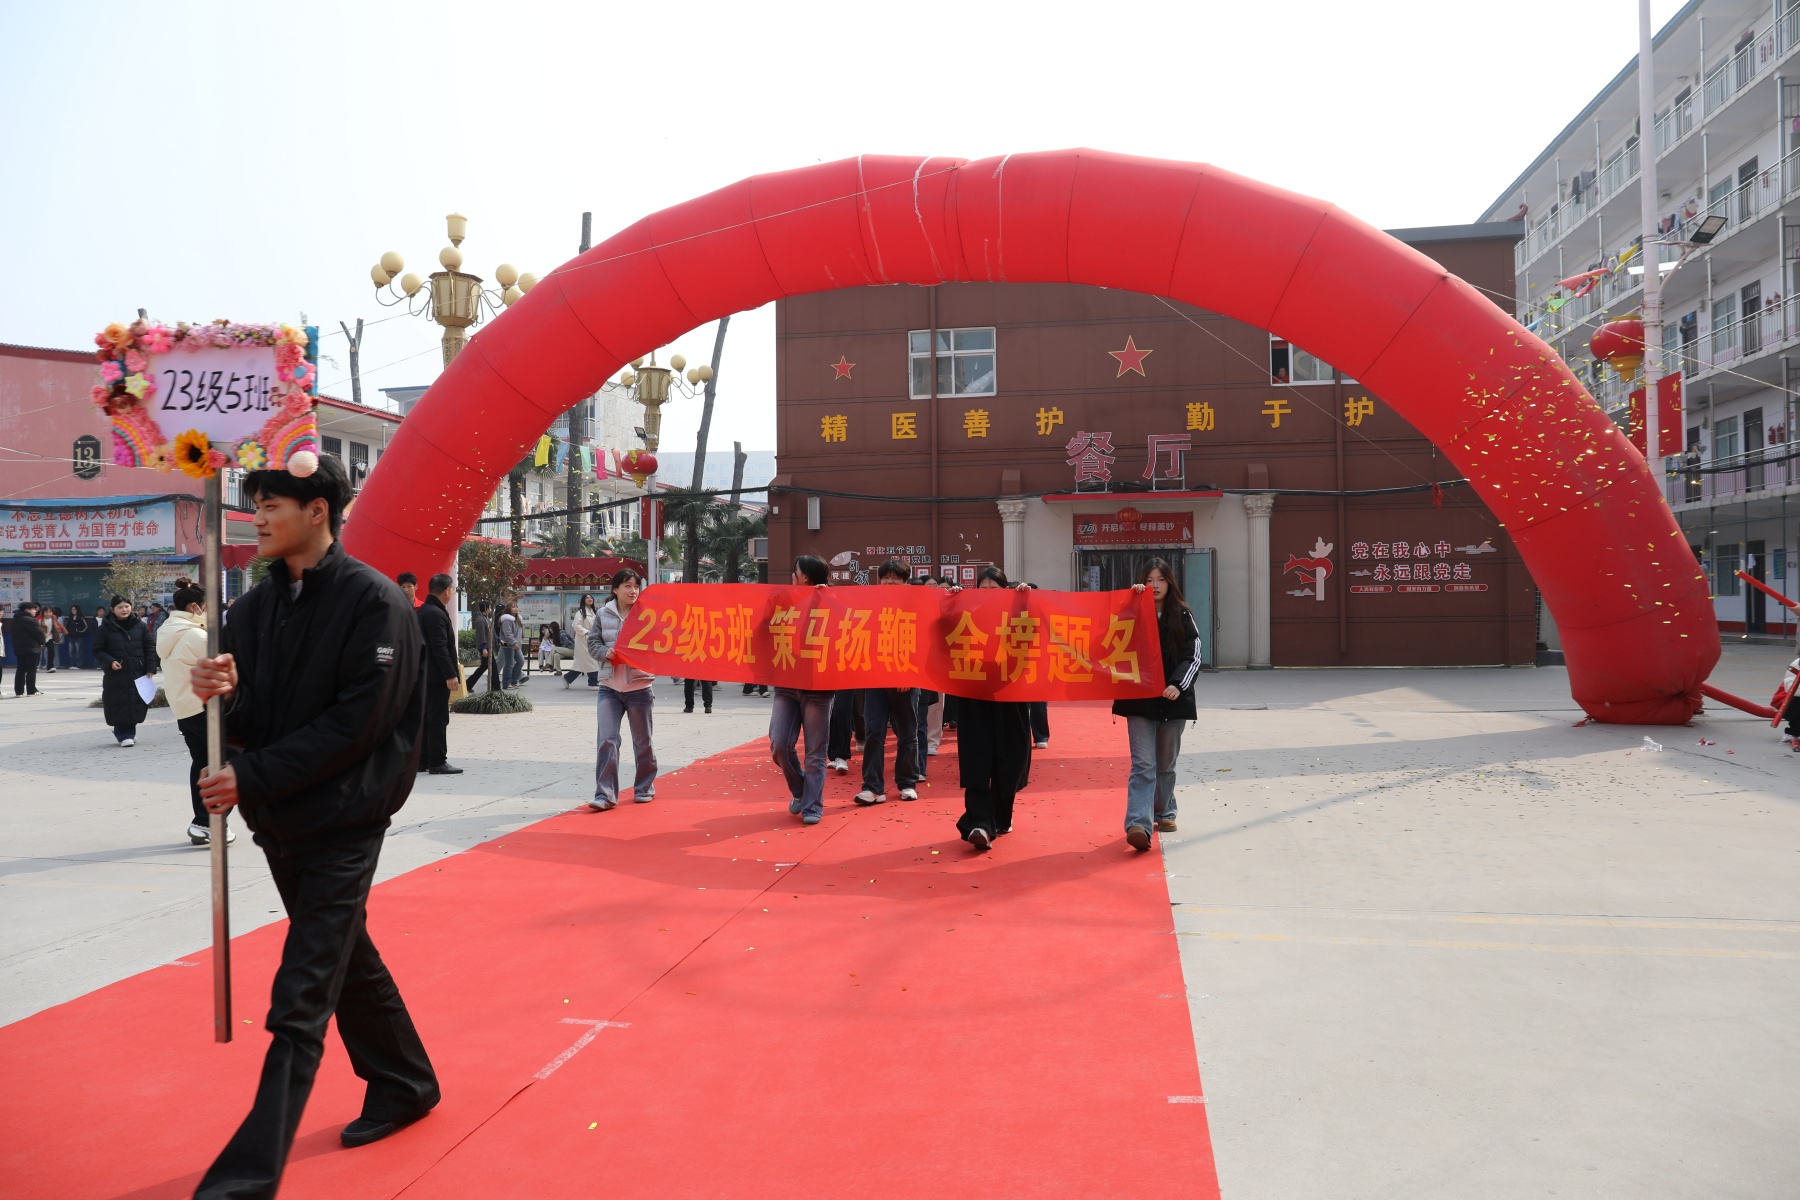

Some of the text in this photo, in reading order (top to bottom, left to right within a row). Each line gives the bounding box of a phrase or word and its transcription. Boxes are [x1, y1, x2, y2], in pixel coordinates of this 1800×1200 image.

[161, 369, 270, 414] 23级5班
[821, 396, 1375, 443] 精医善护 勤于护
[74, 446, 95, 469] 13
[1065, 430, 1192, 483] 餐厅
[78, 520, 159, 537] 为国育才使命
[1352, 541, 1452, 560] 党在我心中
[830, 571, 851, 581] 党建
[1373, 563, 1472, 581] 永远跟党走
[628, 602, 1142, 683] 23级5班 策马扬鞭 金榜题名
